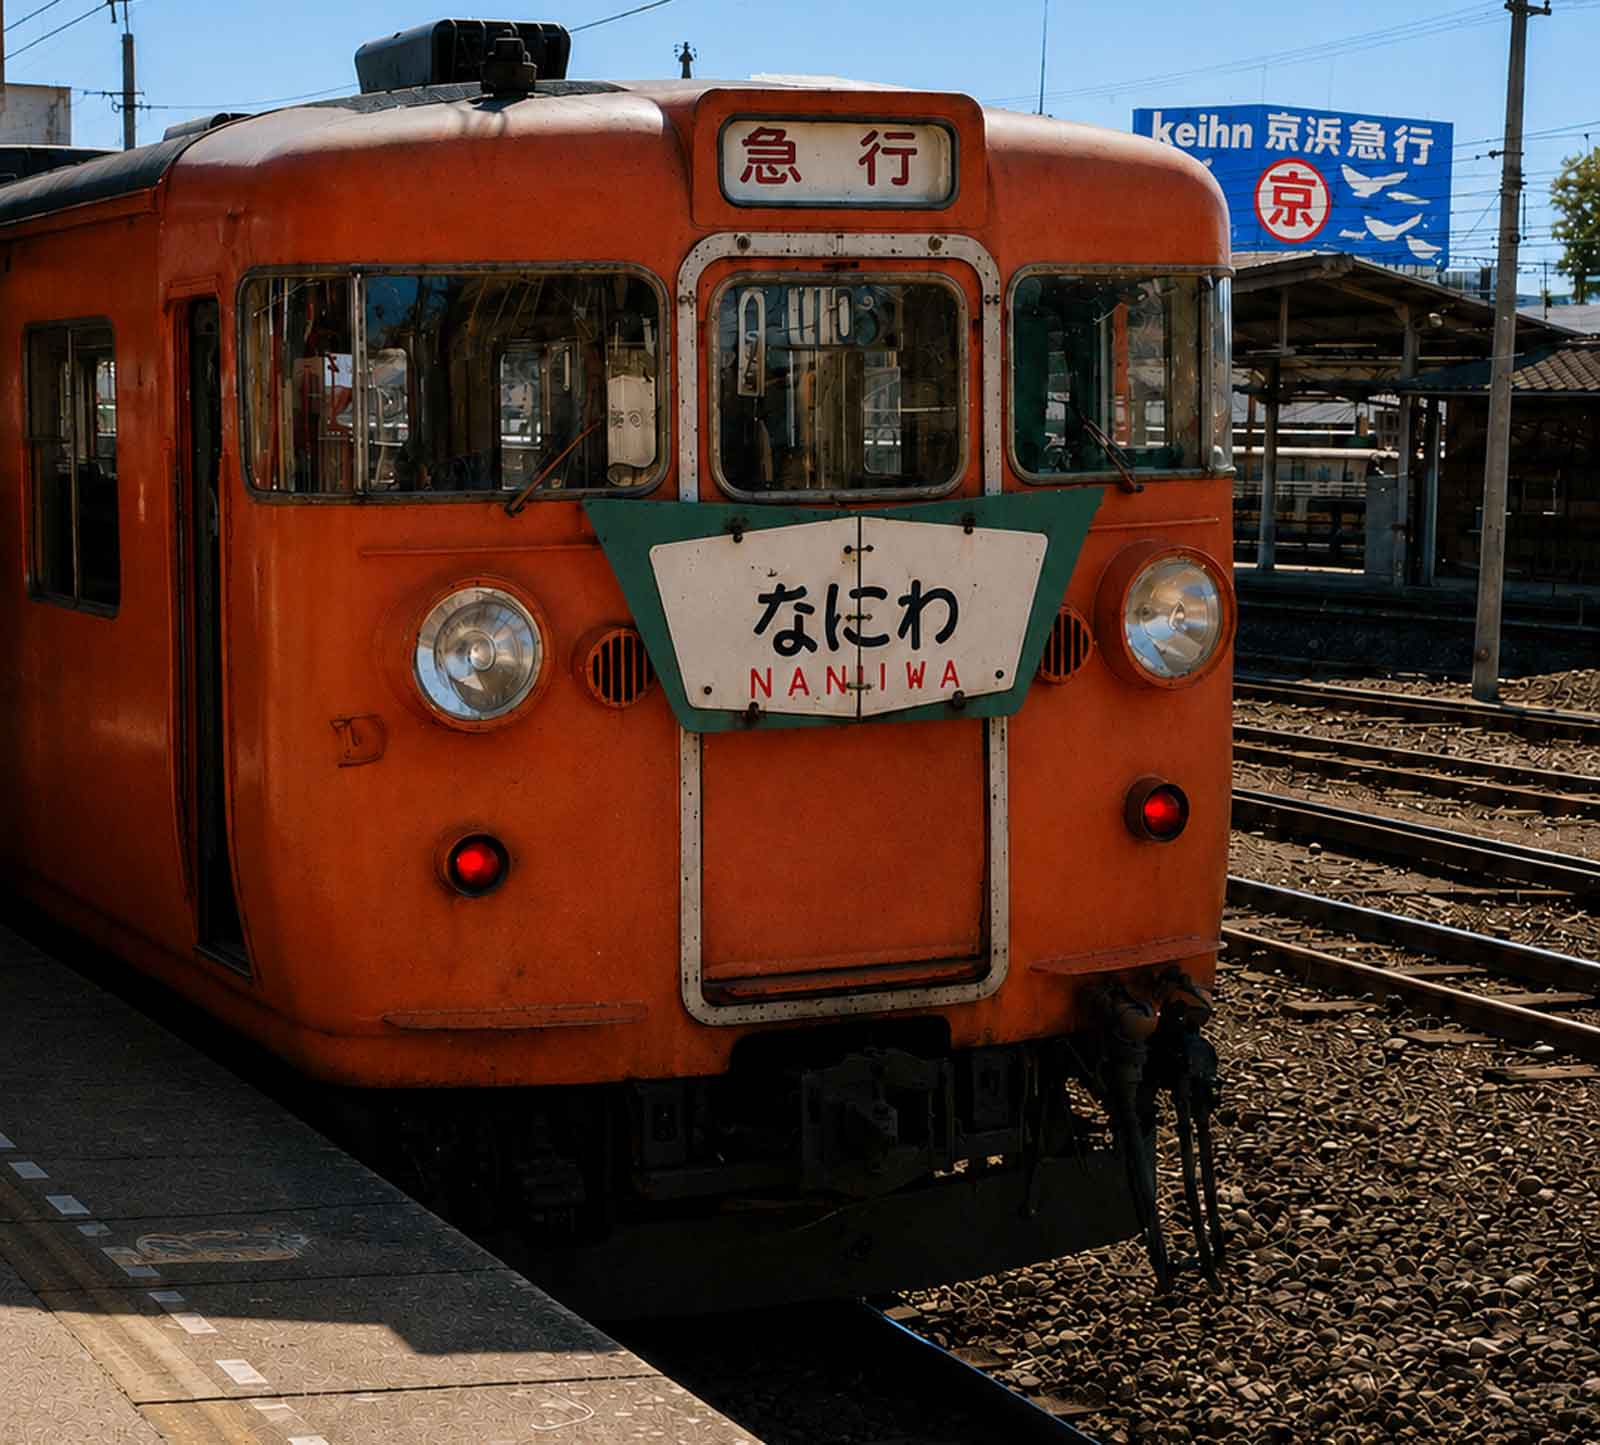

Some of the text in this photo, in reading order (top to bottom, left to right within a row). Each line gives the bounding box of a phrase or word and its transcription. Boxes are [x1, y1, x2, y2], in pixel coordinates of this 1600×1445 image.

[740, 126, 918, 186] 急行
[1152, 111, 1434, 166] keihn 京浜急行
[1268, 170, 1317, 228] 京
[753, 579, 959, 657] なにわ
